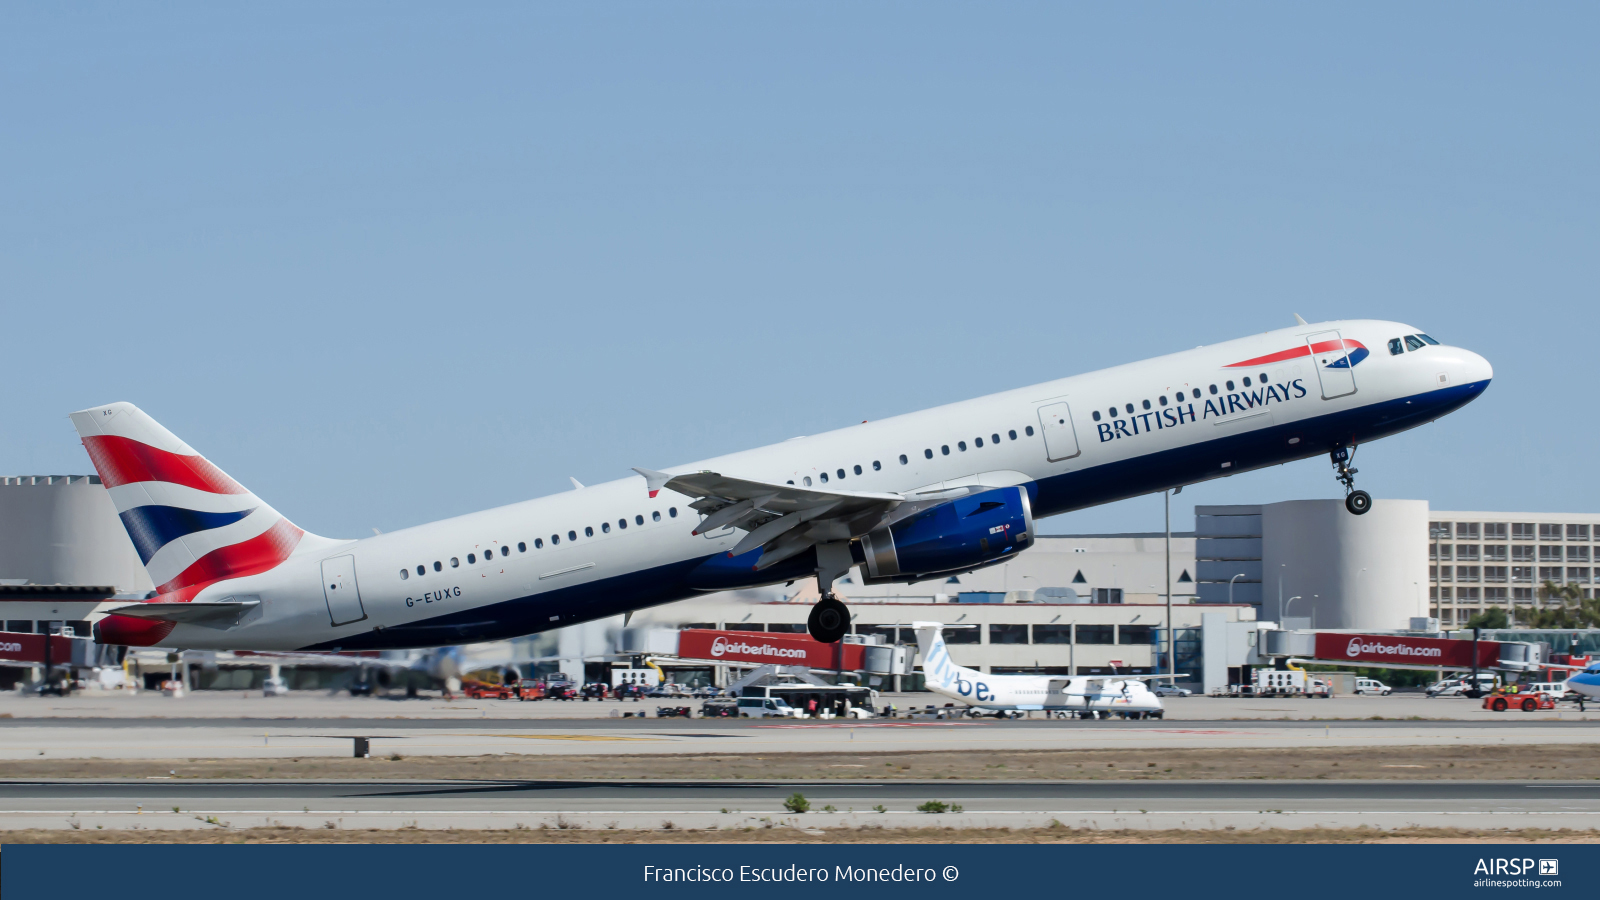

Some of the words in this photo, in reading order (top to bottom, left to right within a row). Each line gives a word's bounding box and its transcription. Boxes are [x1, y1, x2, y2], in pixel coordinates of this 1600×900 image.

[1097, 403, 1196, 443] BRITISH
[1202, 378, 1307, 420] AIRWAYS
[1336, 451, 1346, 459] XG
[405, 586, 461, 608] G-EUXG
[725, 642, 807, 659] airberlin.com
[1360, 642, 1442, 657] airberlin.com
